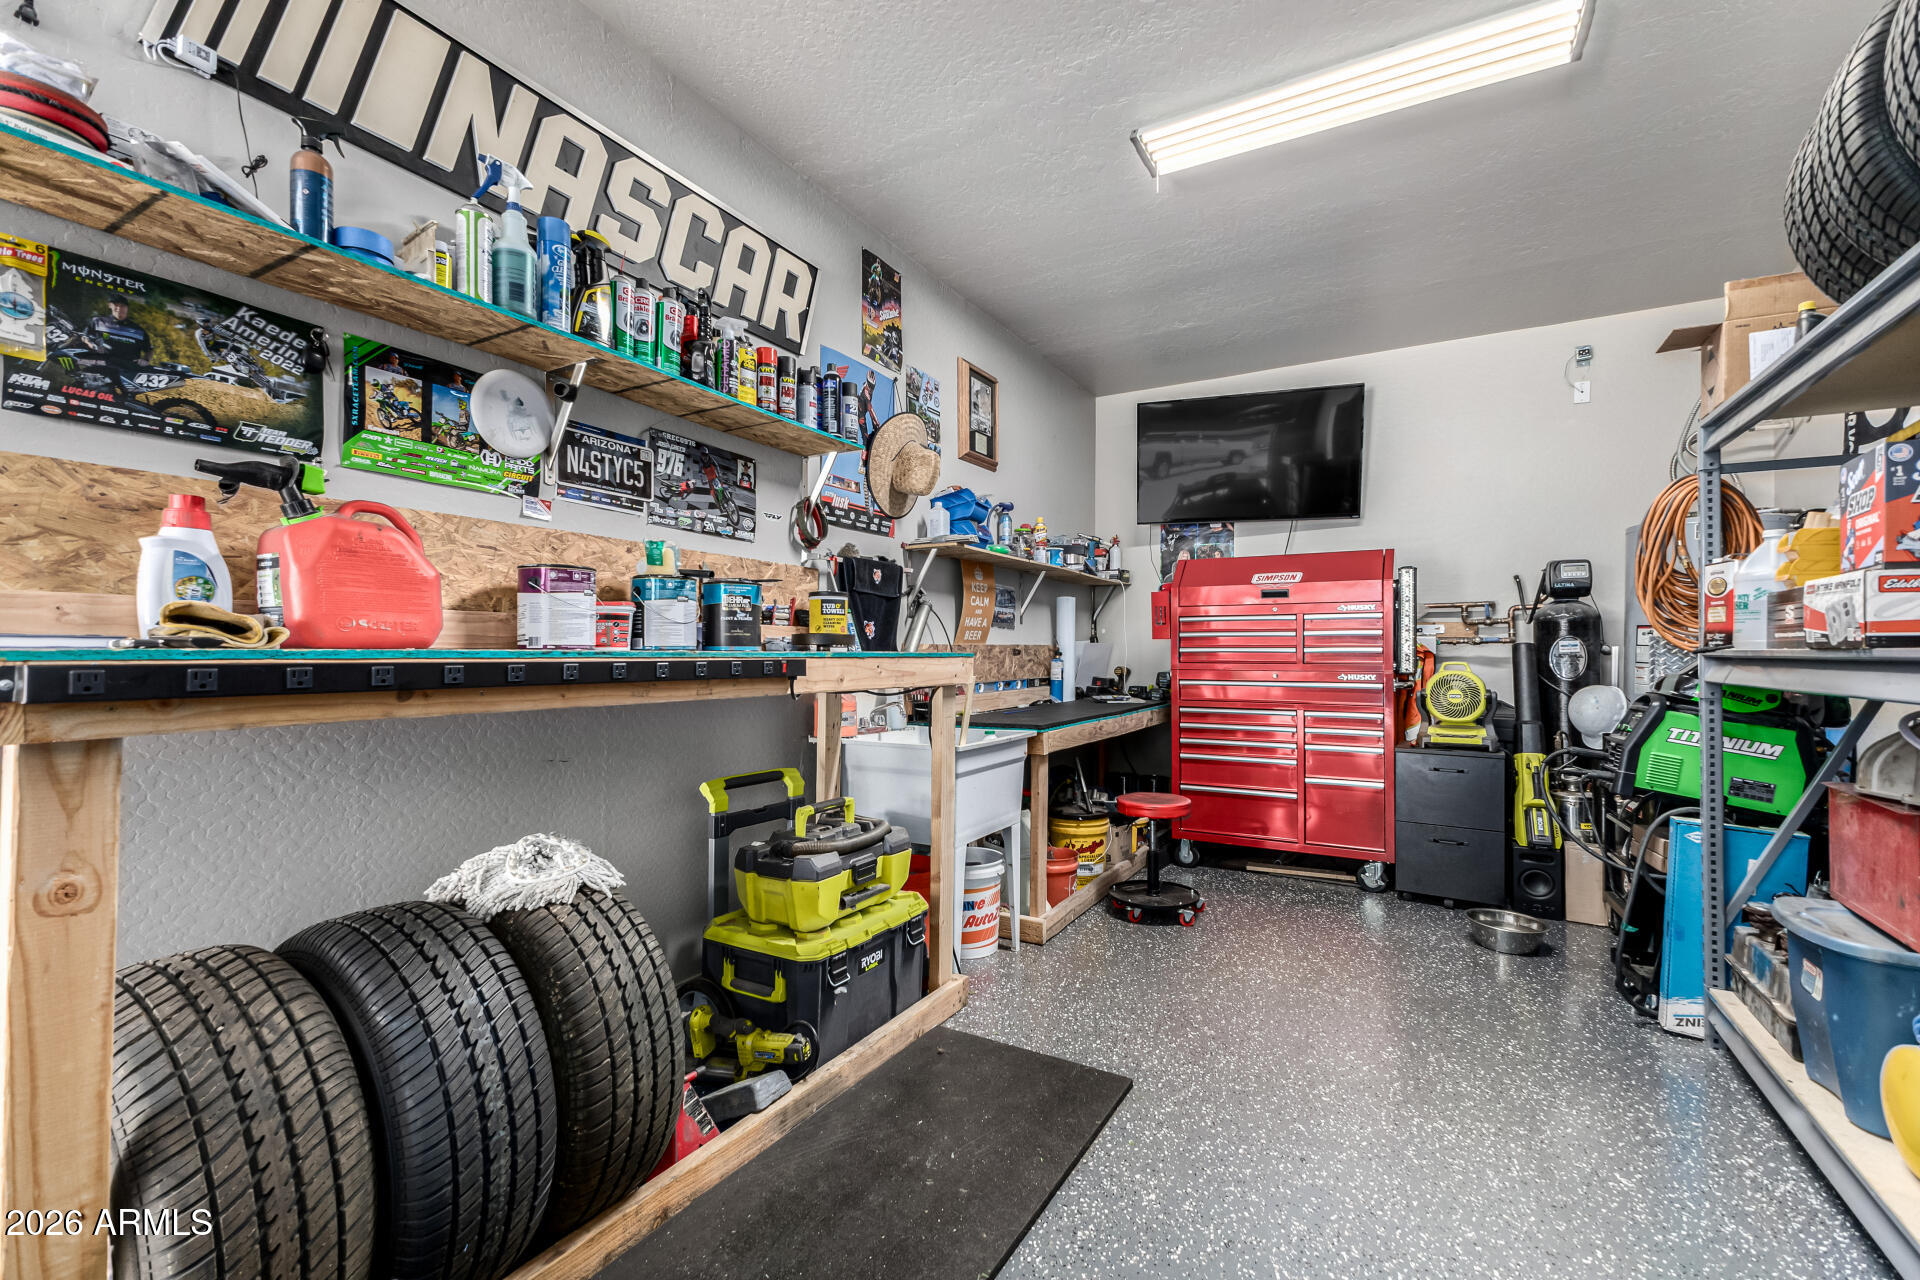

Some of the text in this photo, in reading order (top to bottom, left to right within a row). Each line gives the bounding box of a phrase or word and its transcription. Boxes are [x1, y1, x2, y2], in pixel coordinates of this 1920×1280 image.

[423, 49, 813, 340] NASCAR
[35, 244, 46, 255] 6
[61, 261, 146, 293] MONSTER
[236, 306, 308, 349] Kaede
[221, 316, 304, 364] Amerin
[259, 349, 305, 376] 2022
[720, 339, 732, 393] CERAMIC
[136, 373, 170, 388] 432
[61, 385, 115, 403] LUCAS OIL
[581, 435, 632, 455] ARIZONA
[566, 444, 645, 488] N4STYC5
[656, 448, 685, 477] 976
[1848, 488, 1876, 517] SHOP
[971, 582, 988, 593] KEEP
[1256, 574, 1298, 582] SIMPSON
[970, 595, 989, 607] CALM
[964, 616, 987, 628] HAVE A
[964, 630, 982, 640] BEER
[1667, 727, 1785, 757] TITNIUM
[861, 949, 883, 969] RYOBI
